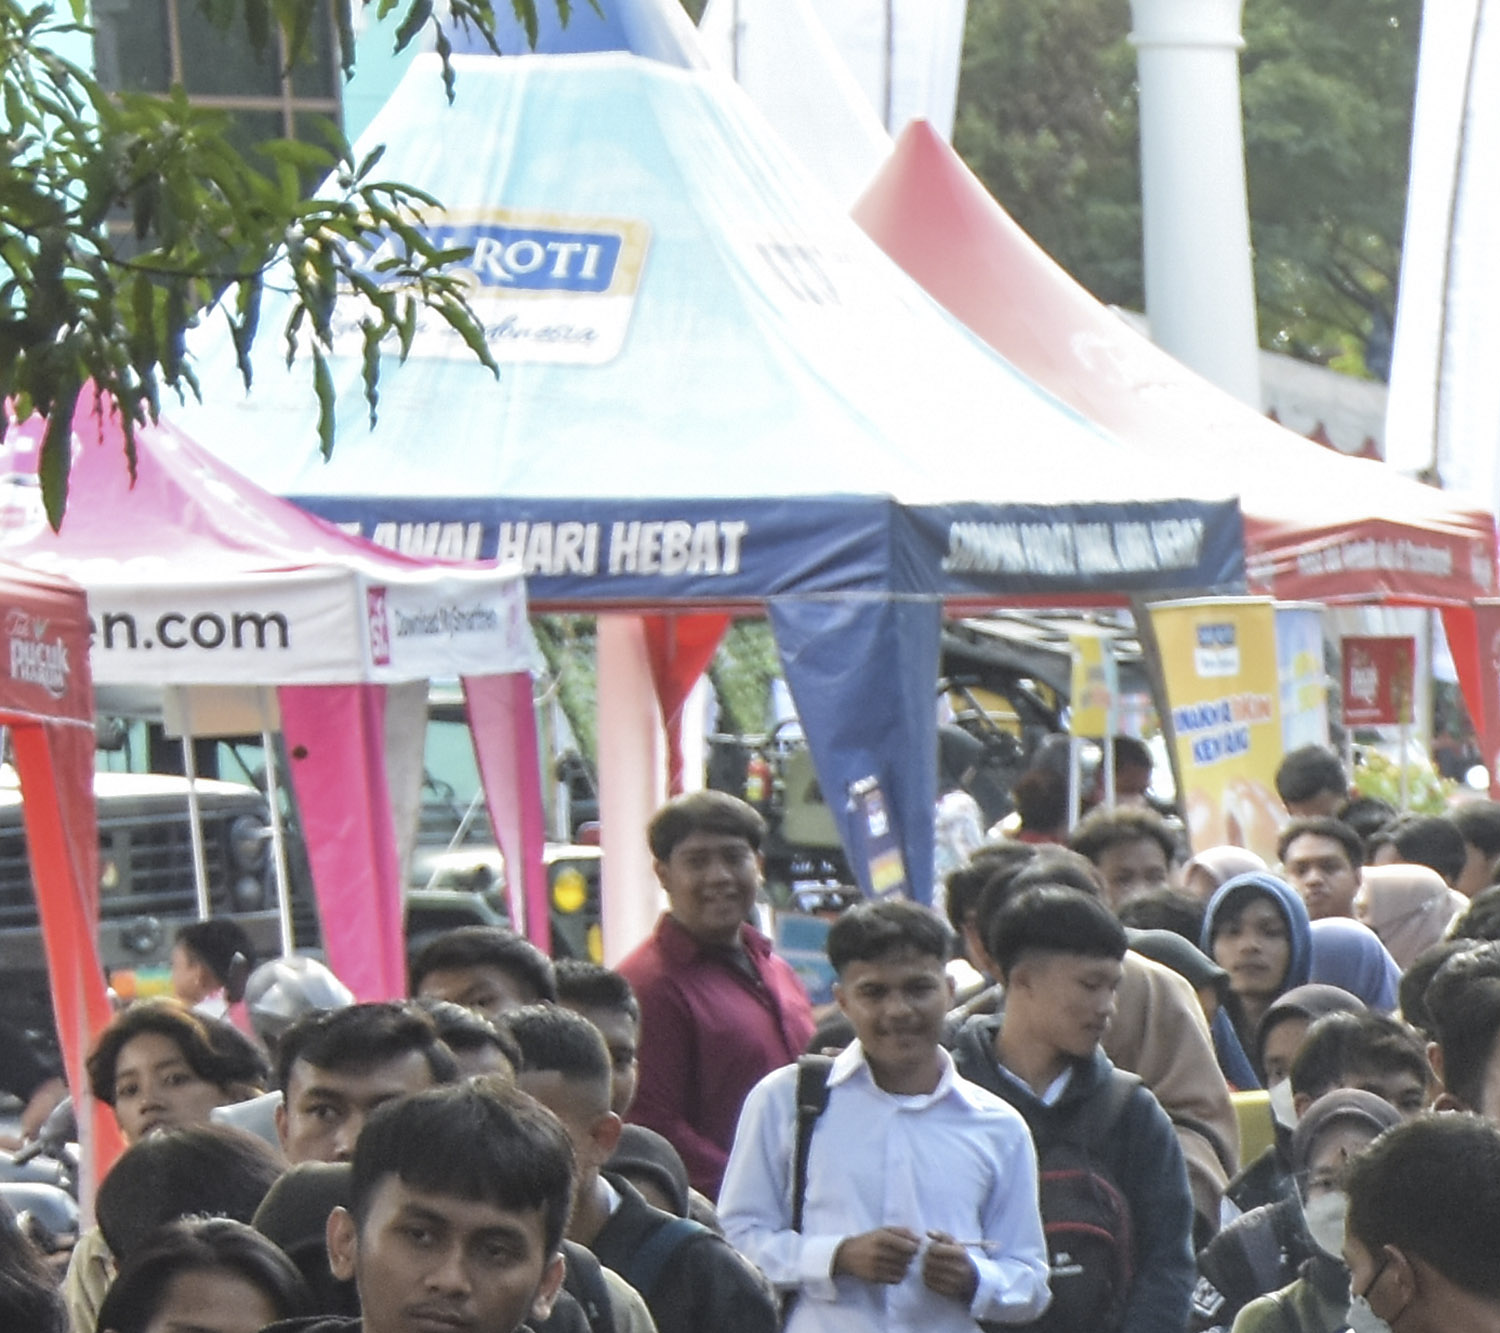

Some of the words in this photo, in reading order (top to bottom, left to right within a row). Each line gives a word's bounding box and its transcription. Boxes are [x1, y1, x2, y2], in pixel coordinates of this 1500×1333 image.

[472, 236, 602, 281] ROTI
[498, 520, 600, 577] HARI
[607, 519, 748, 577] HEBAT
[87, 611, 290, 649] n.com
